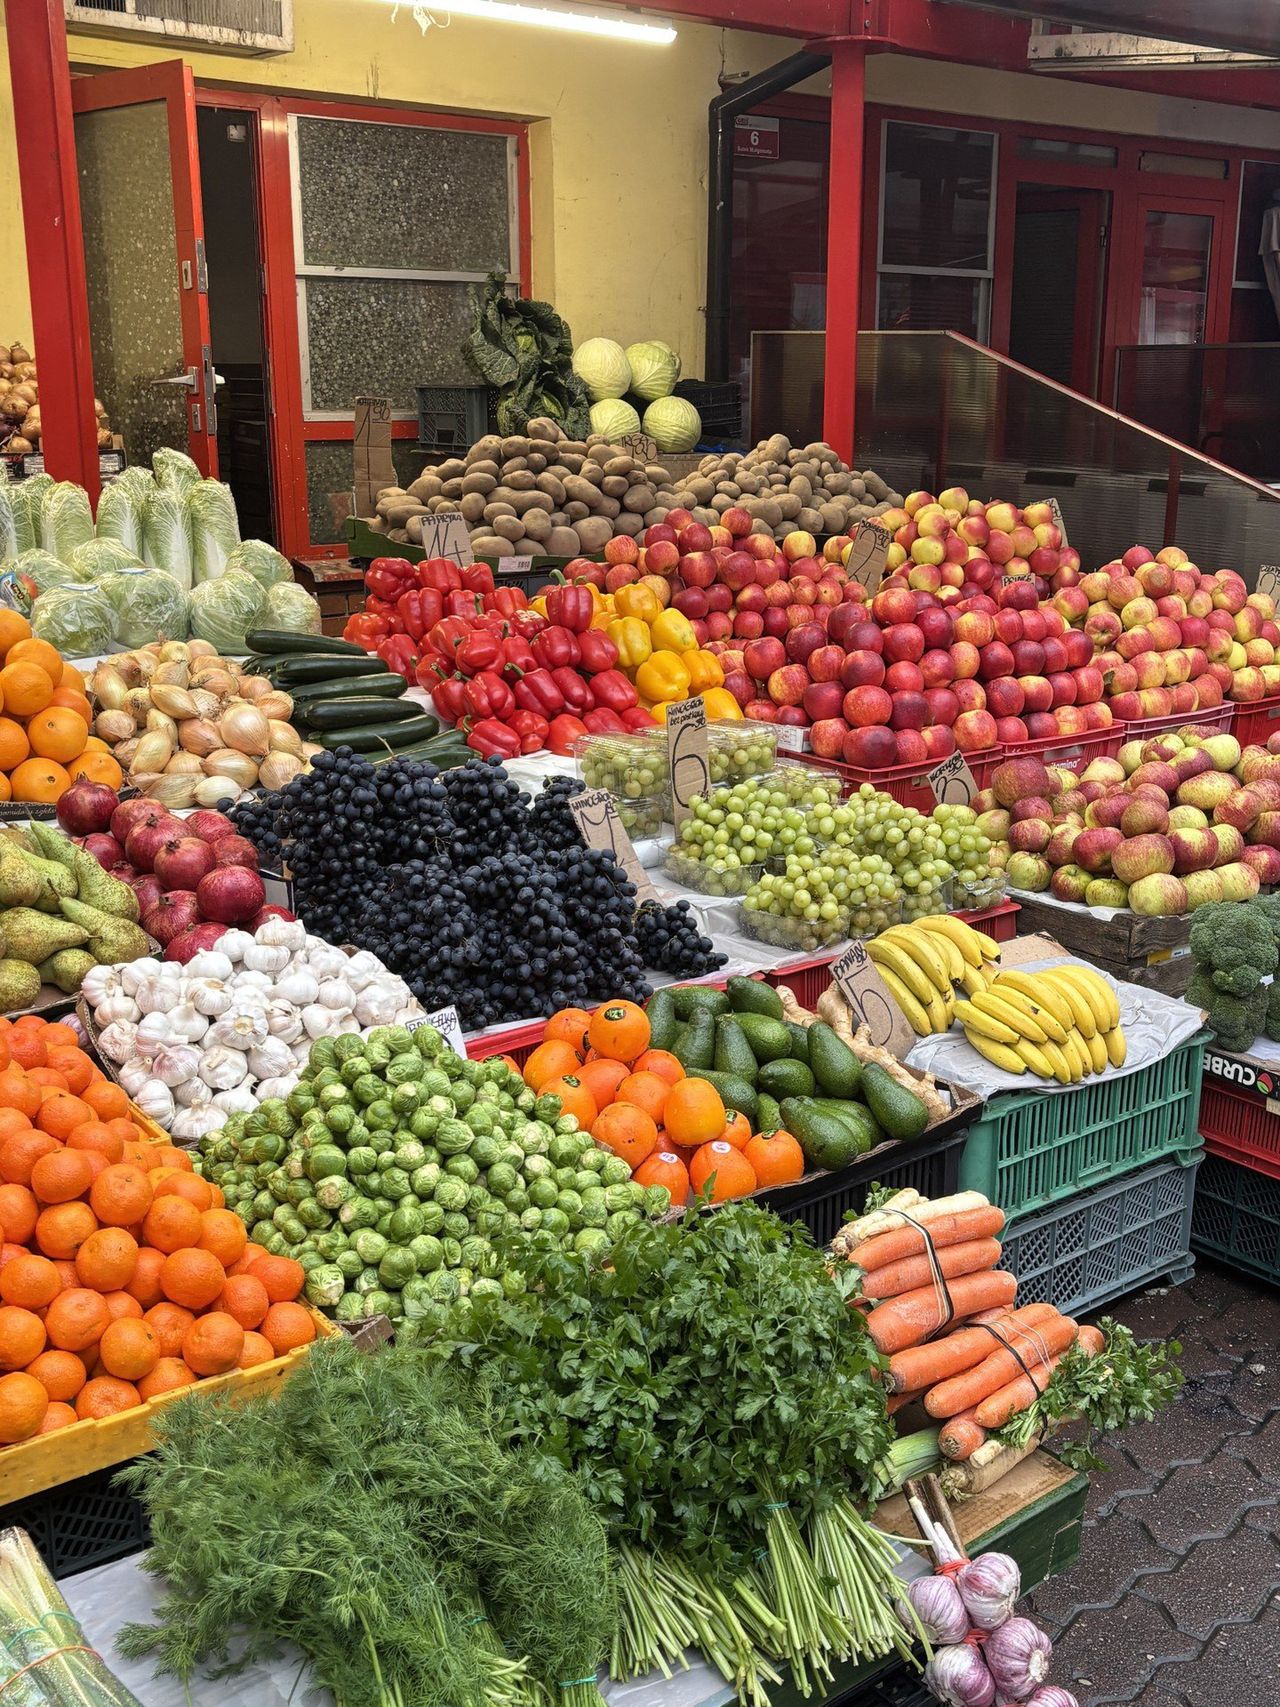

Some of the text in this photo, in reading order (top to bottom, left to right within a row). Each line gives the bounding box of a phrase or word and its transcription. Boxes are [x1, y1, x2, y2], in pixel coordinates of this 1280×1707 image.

[750, 131, 760, 146] 6
[671, 722, 708, 808] 6
[1202, 1053, 1256, 1086] CURBE
